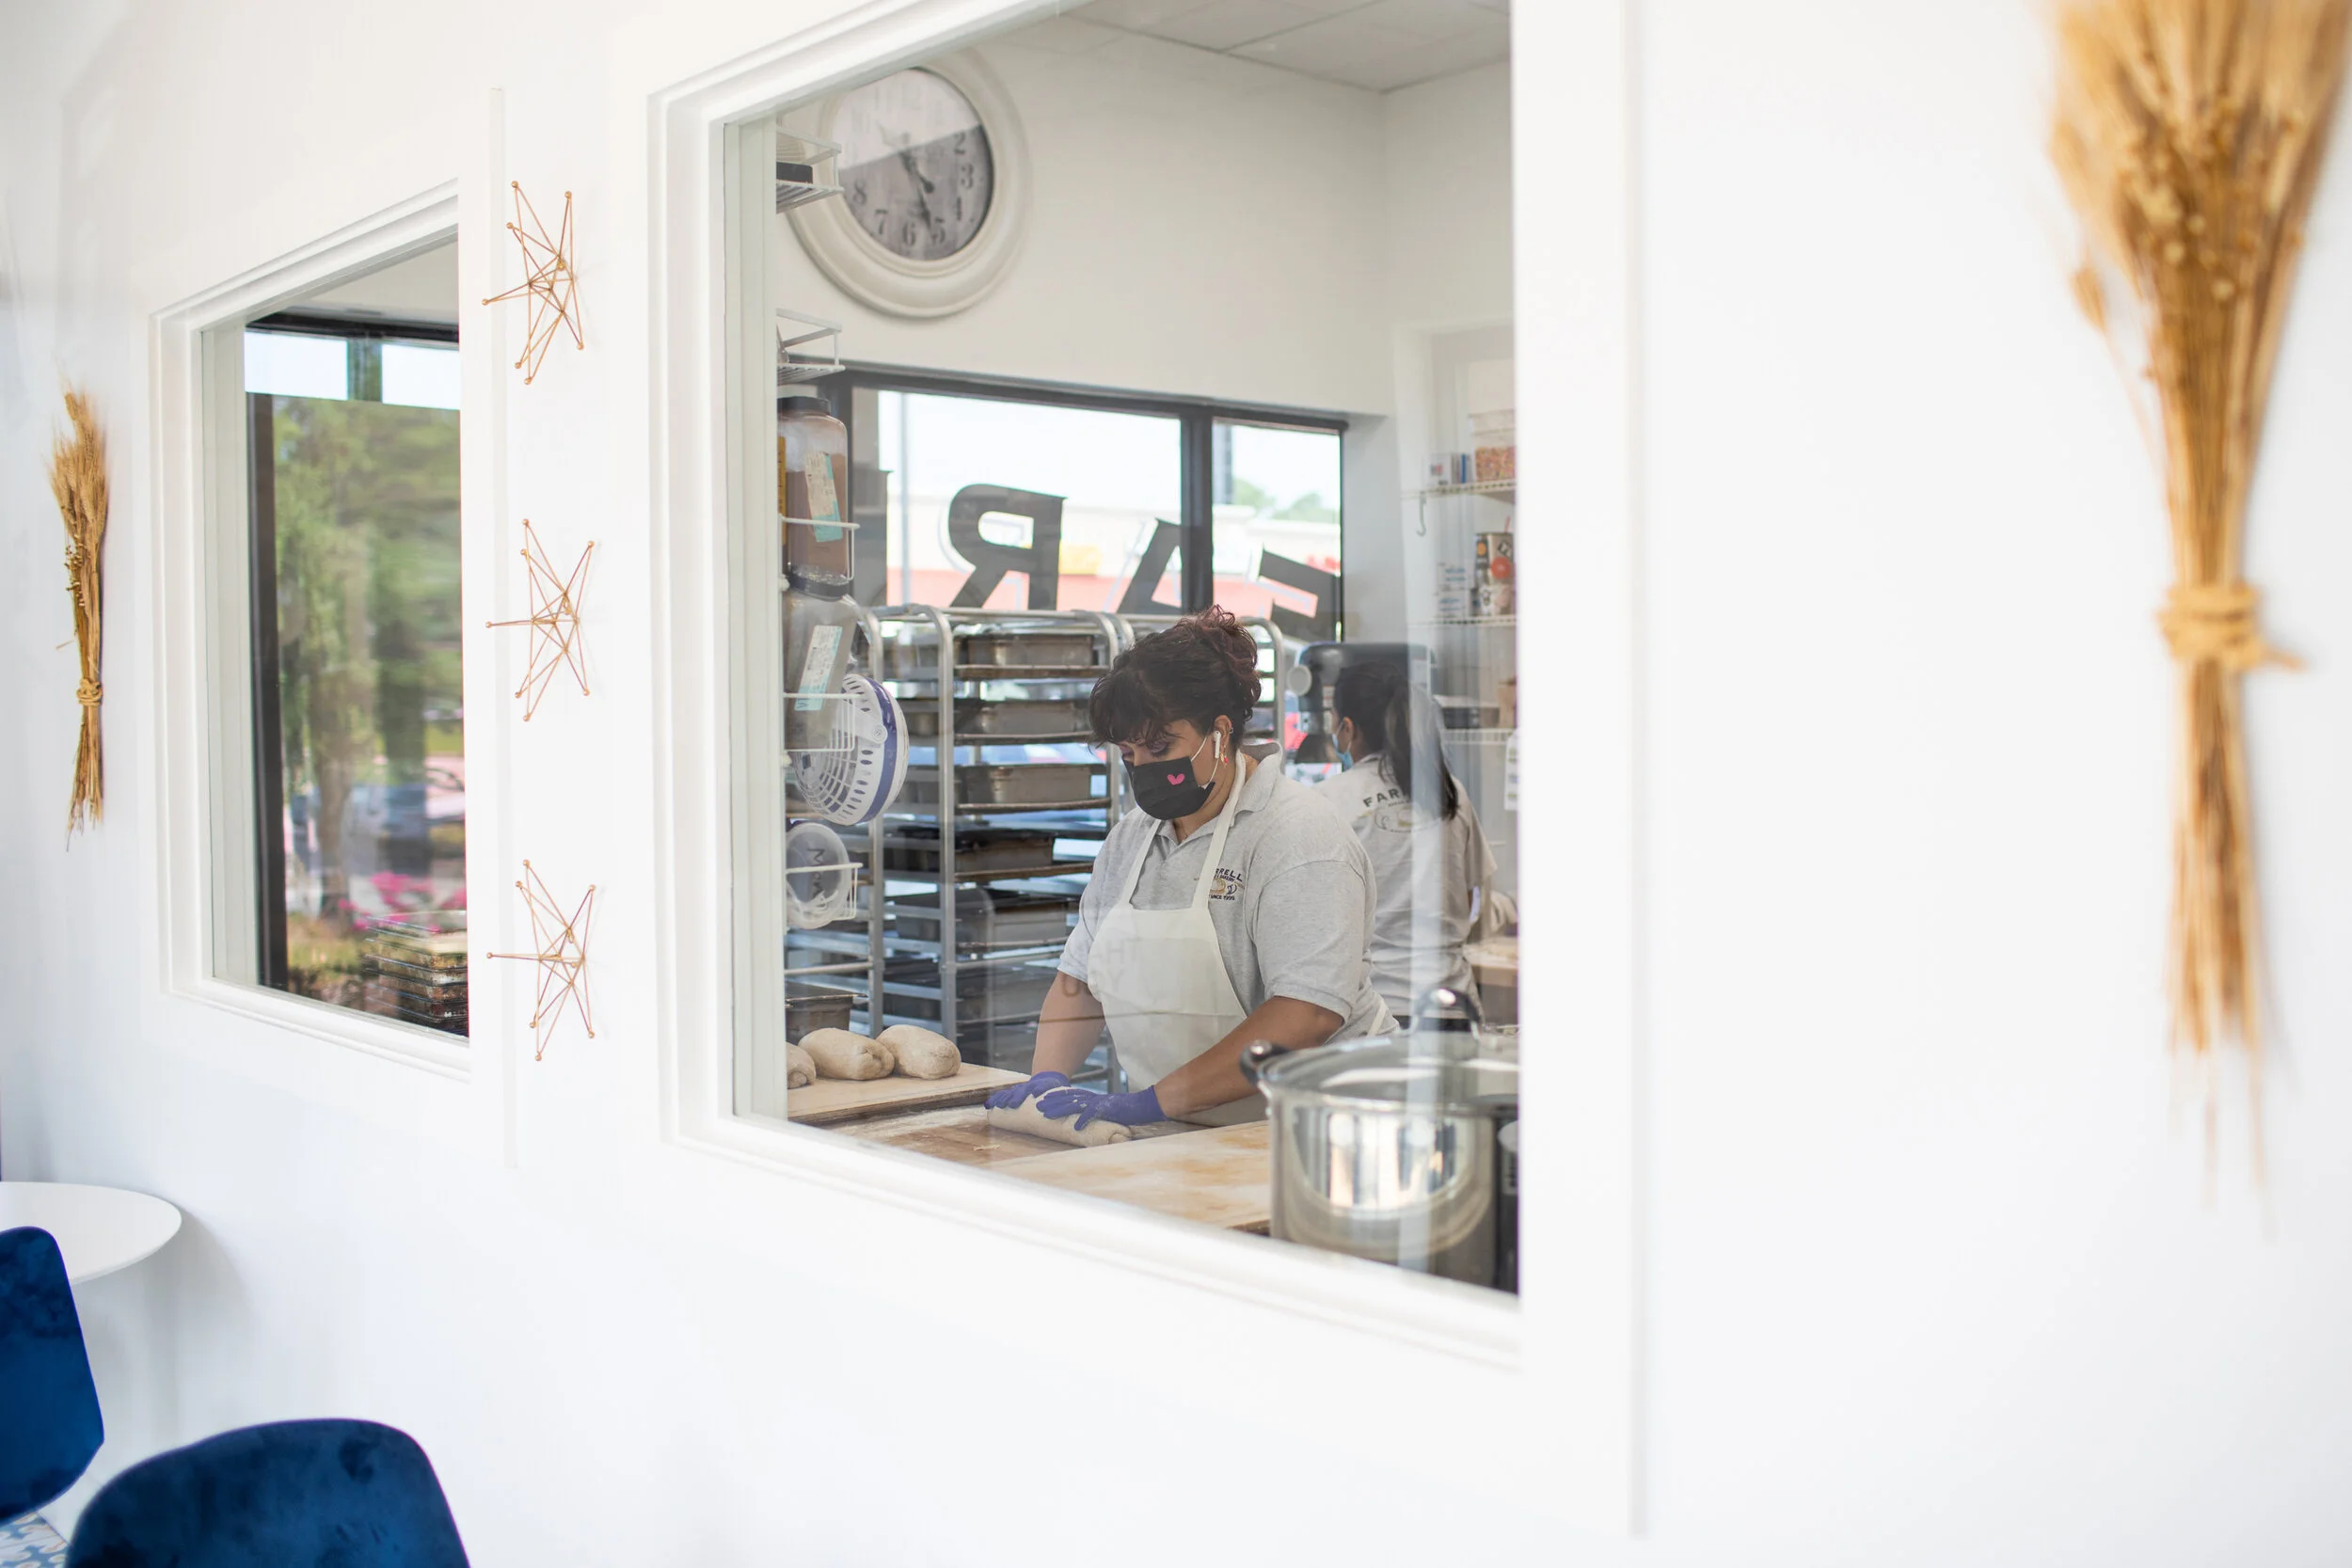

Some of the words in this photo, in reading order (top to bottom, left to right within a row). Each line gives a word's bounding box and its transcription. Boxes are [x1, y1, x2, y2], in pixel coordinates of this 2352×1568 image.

[961, 164, 975, 189] 3
[852, 178, 867, 206] 8
[875, 209, 888, 235] 7
[902, 221, 916, 246] 6
[930, 216, 946, 245] 5
[1363, 788, 1400, 807] FAR
